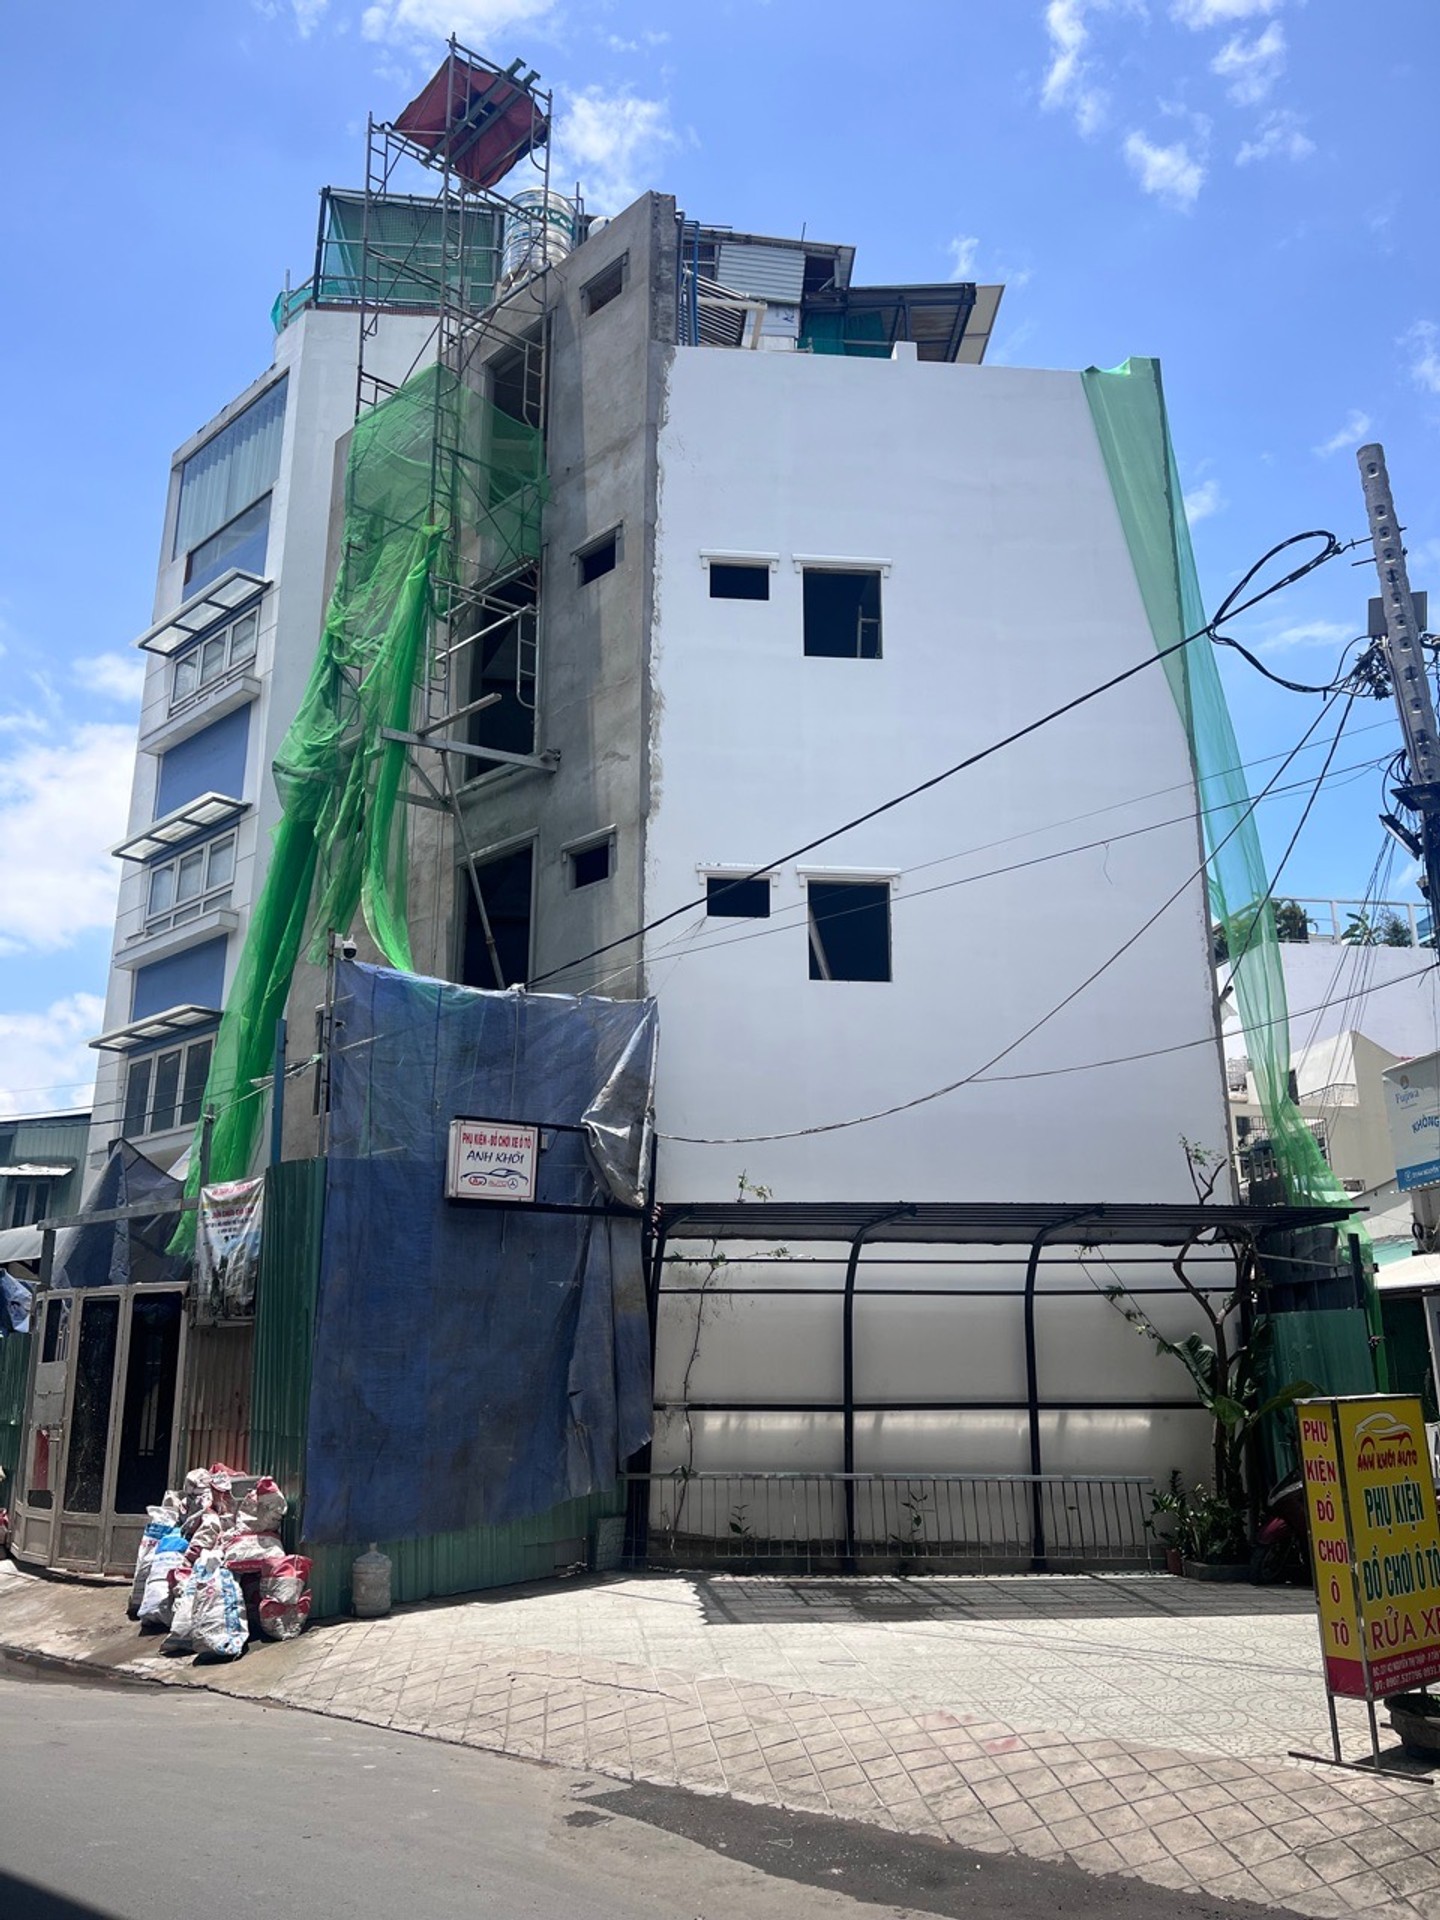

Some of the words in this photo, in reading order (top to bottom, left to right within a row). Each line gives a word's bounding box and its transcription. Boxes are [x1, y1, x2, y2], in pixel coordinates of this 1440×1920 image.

[466, 1149, 493, 1163] ANH
[1302, 1420, 1328, 1447] PHỤ
[1305, 1455, 1336, 1486] KIỆN
[1397, 1449, 1418, 1467] AUTO
[1317, 1491, 1335, 1522] ĐỒ
[1363, 1485, 1393, 1535] PHỤ
[1392, 1475, 1425, 1532] KIỆN
[1318, 1537, 1349, 1564] CHƠI
[1362, 1545, 1383, 1601] ĐỒ
[1384, 1547, 1416, 1597] CHƠI
[1415, 1542, 1426, 1591] Ô
[1331, 1575, 1341, 1603] Ô
[1331, 1617, 1349, 1646] TÔ
[1370, 1605, 1418, 1651] RỬA
